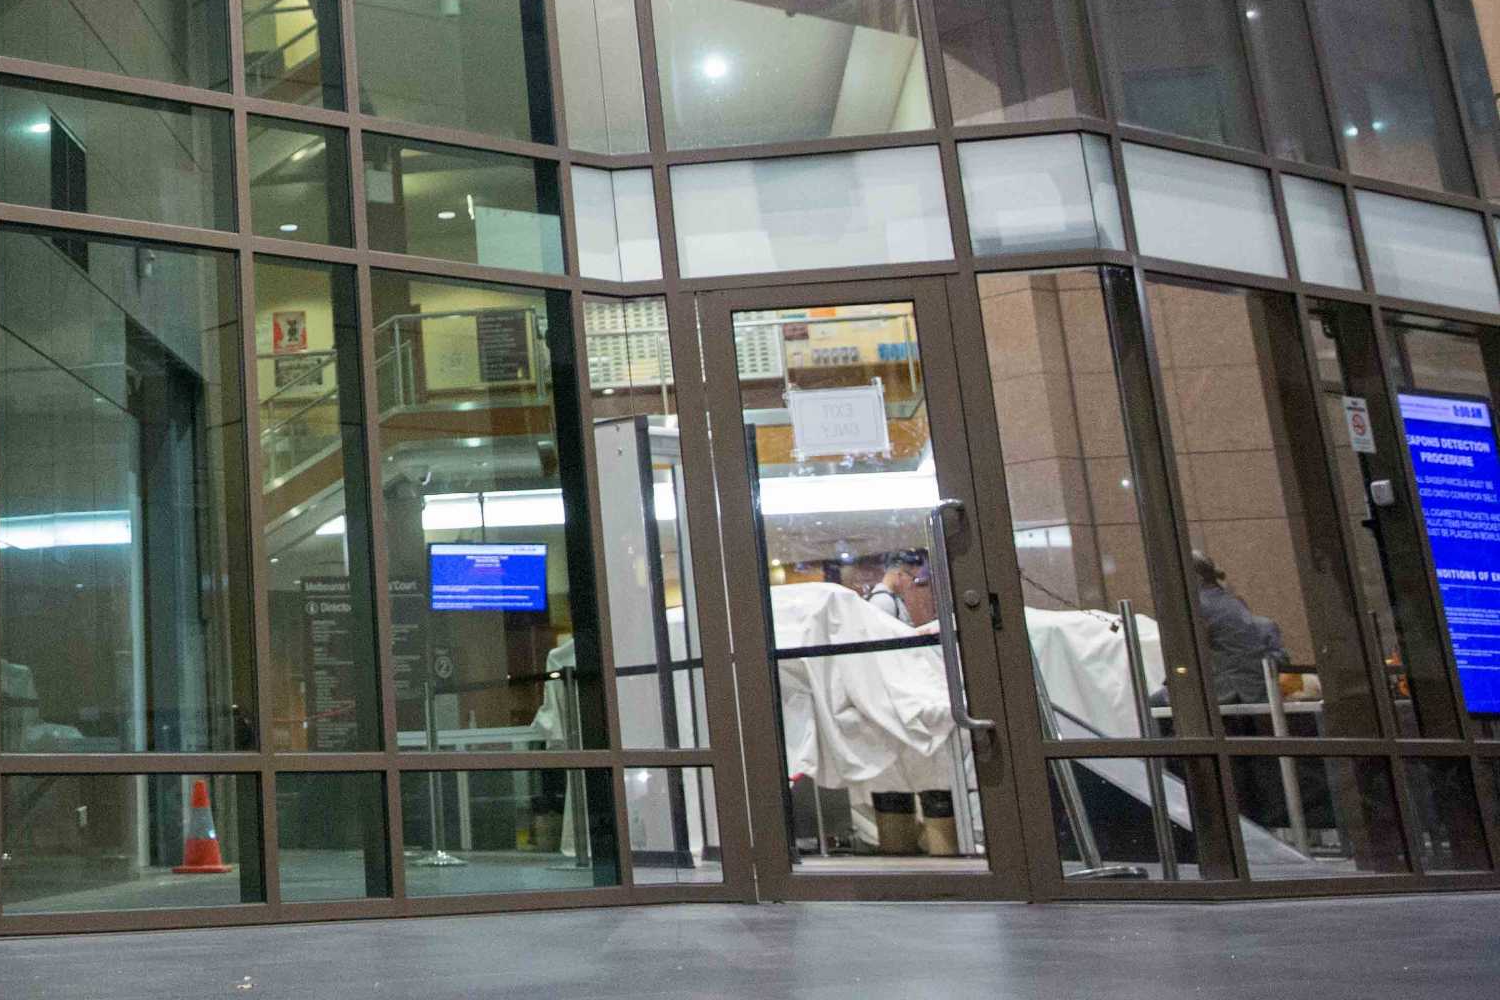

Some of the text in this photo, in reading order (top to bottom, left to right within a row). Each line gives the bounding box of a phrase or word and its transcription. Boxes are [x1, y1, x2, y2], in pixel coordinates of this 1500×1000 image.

[1405, 434, 1491, 453] EAPONS DETECTION
[1420, 451, 1475, 467] PROCEDURE
[1436, 568, 1477, 581] NDITIONS
[320, 602, 352, 613] Directo
